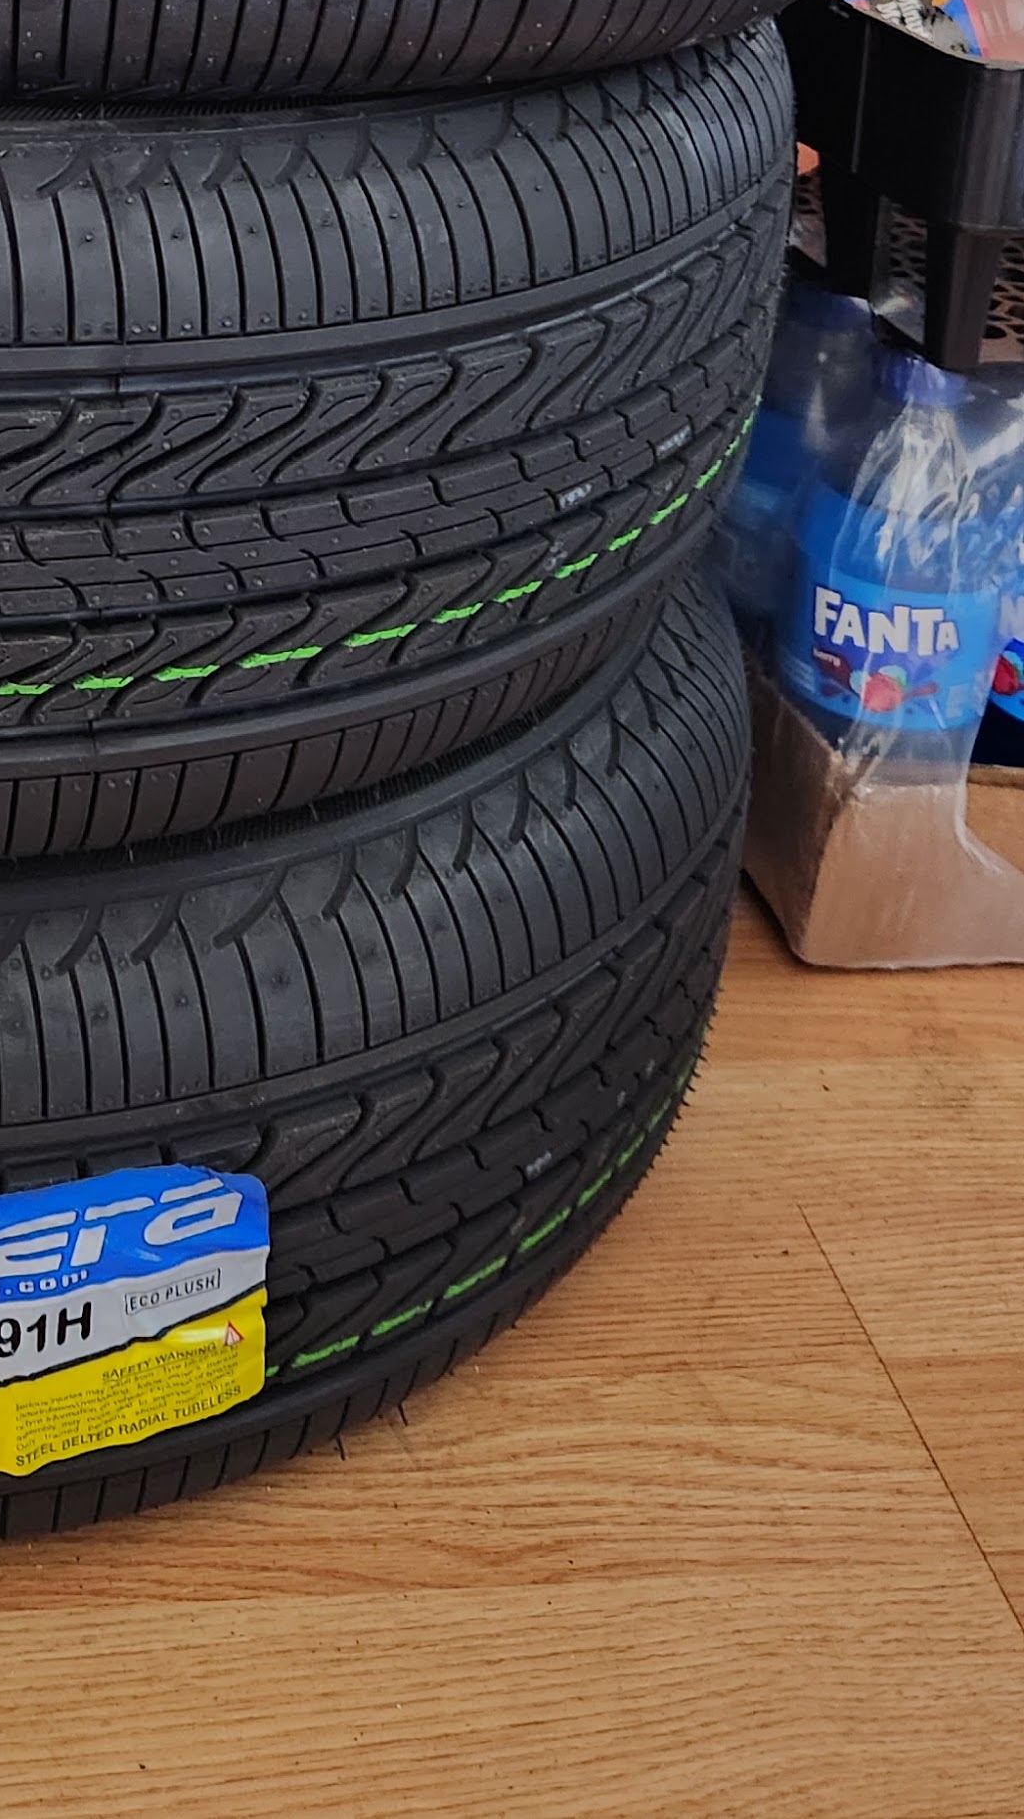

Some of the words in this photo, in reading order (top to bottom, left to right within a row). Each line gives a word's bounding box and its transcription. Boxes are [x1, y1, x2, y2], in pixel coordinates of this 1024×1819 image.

[814, 586, 960, 657] FANTA
[129, 1290, 161, 1311] ECO
[164, 1273, 217, 1302] PLUSH
[102, 1358, 152, 1381] SAFETY
[16, 1445, 57, 1467] STEEL
[62, 1428, 114, 1451] BELTED
[119, 1413, 169, 1435] RADIAL
[174, 1385, 242, 1419] TUBELESS
